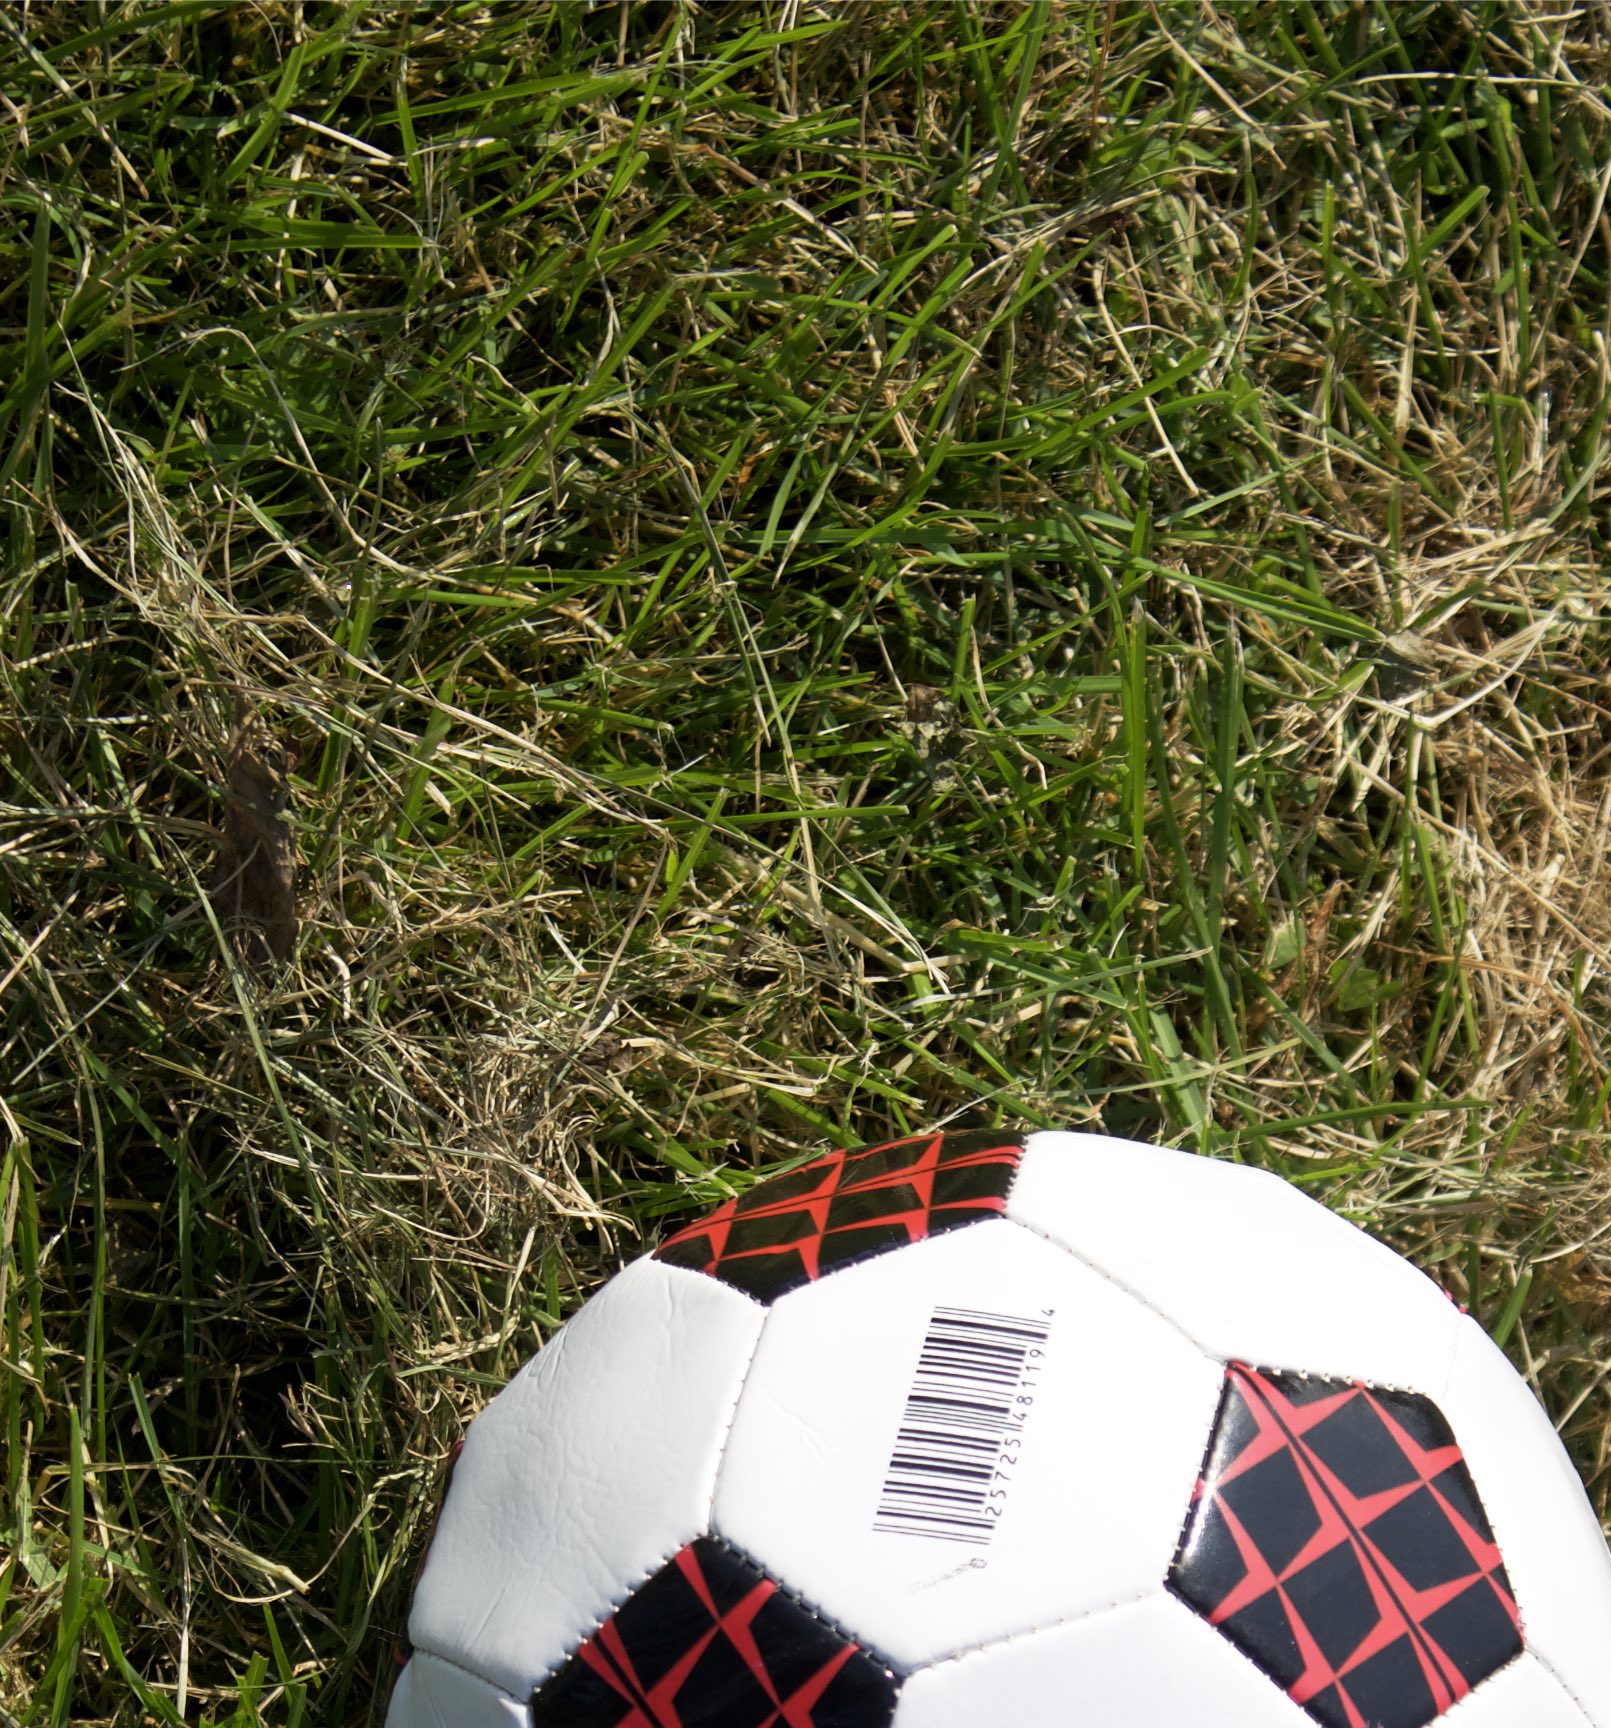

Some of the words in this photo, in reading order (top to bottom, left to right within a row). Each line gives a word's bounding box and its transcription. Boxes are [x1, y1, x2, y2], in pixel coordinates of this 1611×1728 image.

[984, 1437, 1022, 1518] 25725
[1011, 1348, 1047, 1422] 48119
[1040, 1308, 1056, 1318] 4
